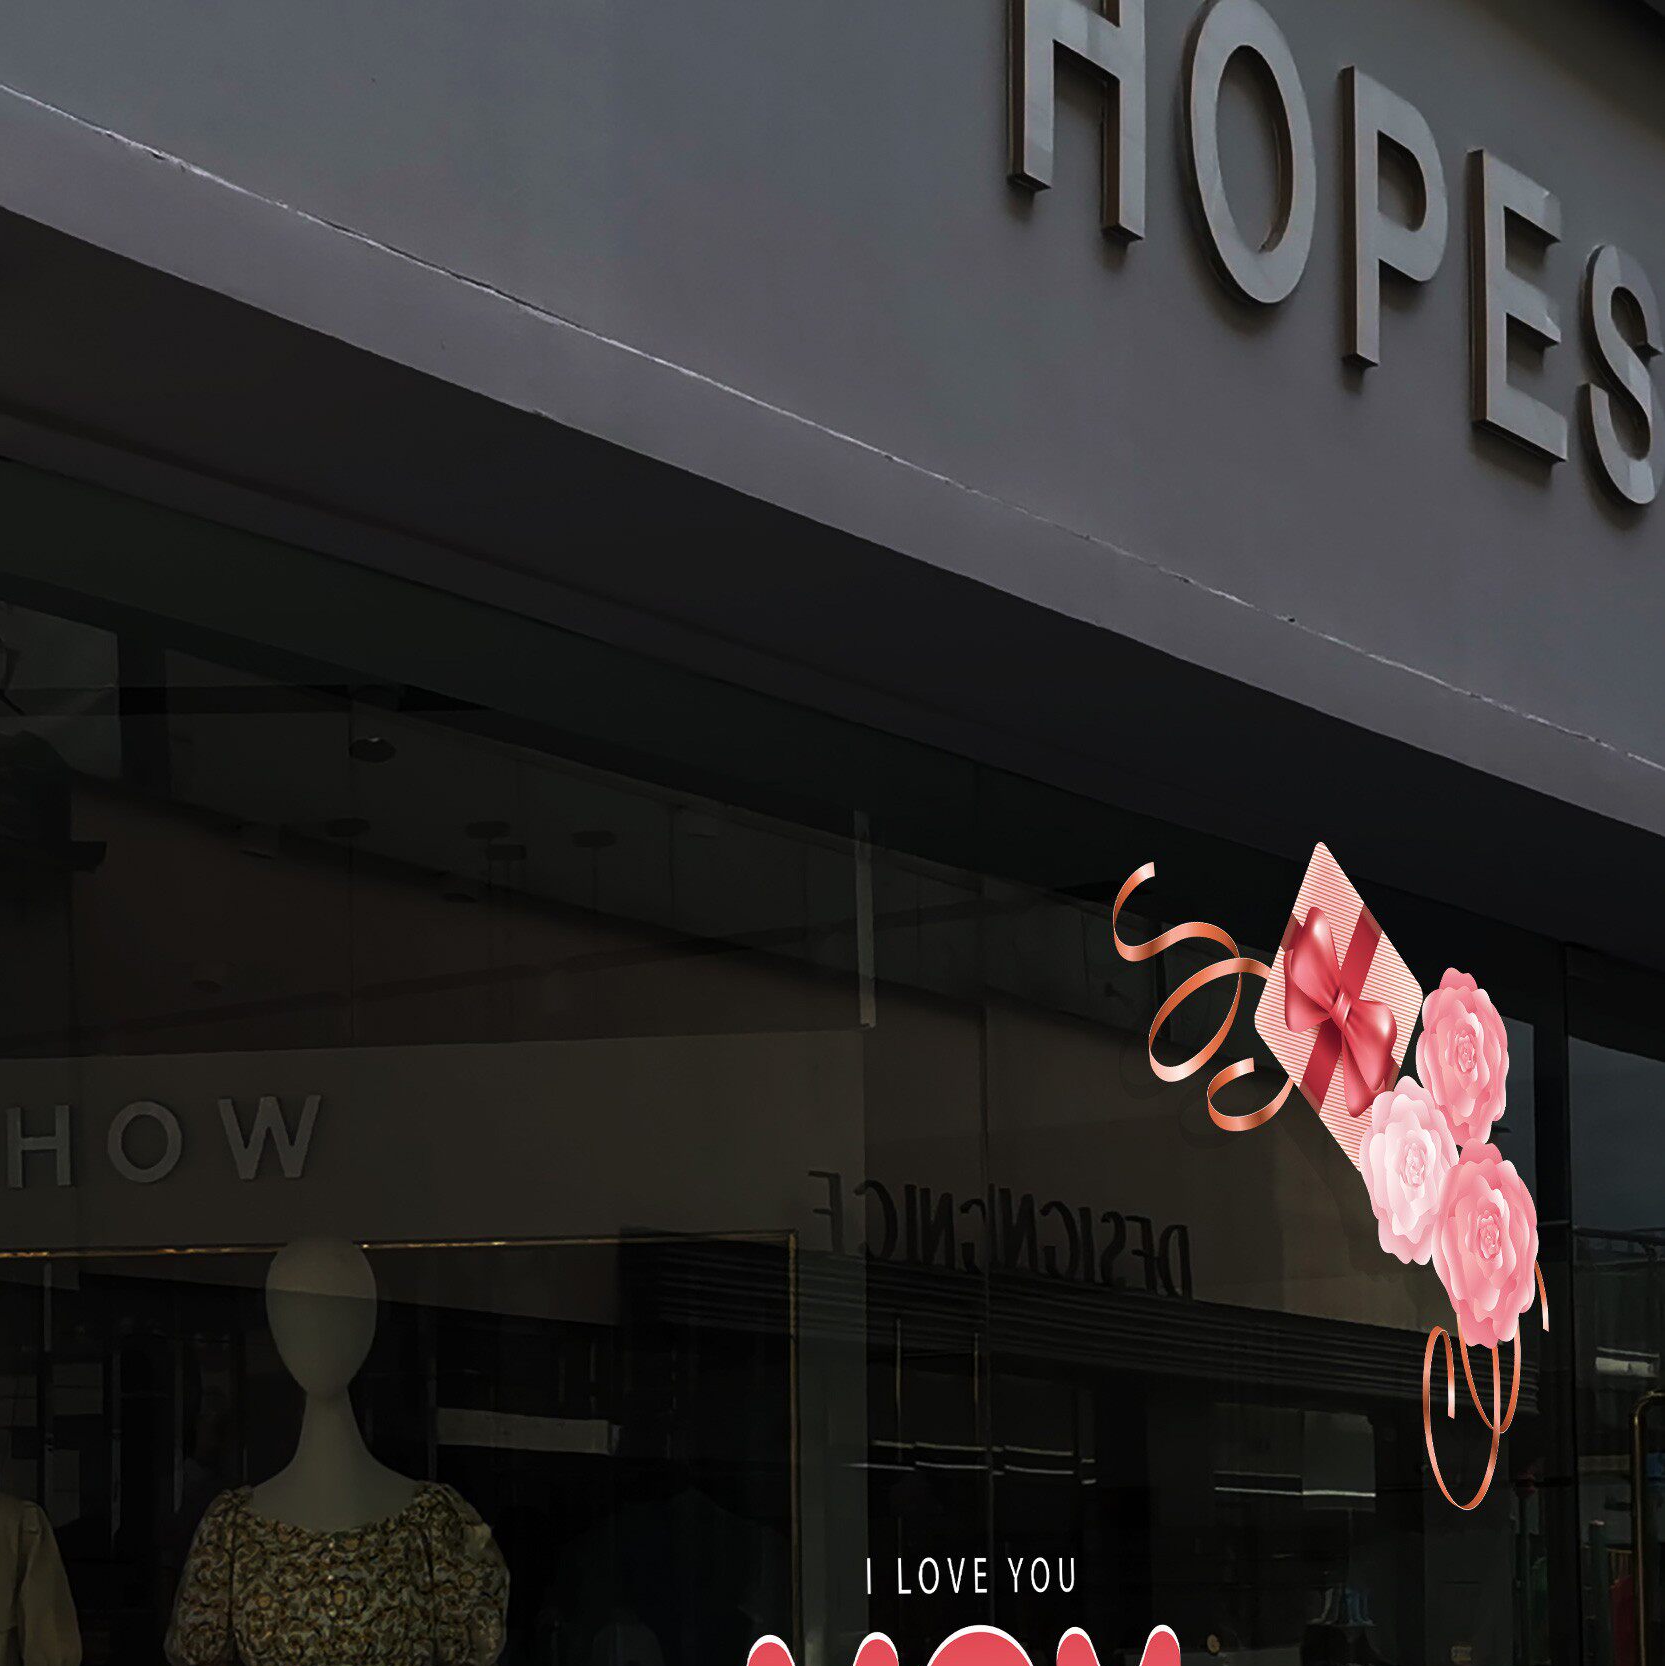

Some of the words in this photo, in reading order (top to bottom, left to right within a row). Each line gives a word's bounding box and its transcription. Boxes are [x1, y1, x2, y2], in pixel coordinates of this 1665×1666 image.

[866, 1557, 872, 1595] I
[897, 1557, 988, 1595] LOVE
[1007, 1556, 1076, 1594] YOU
